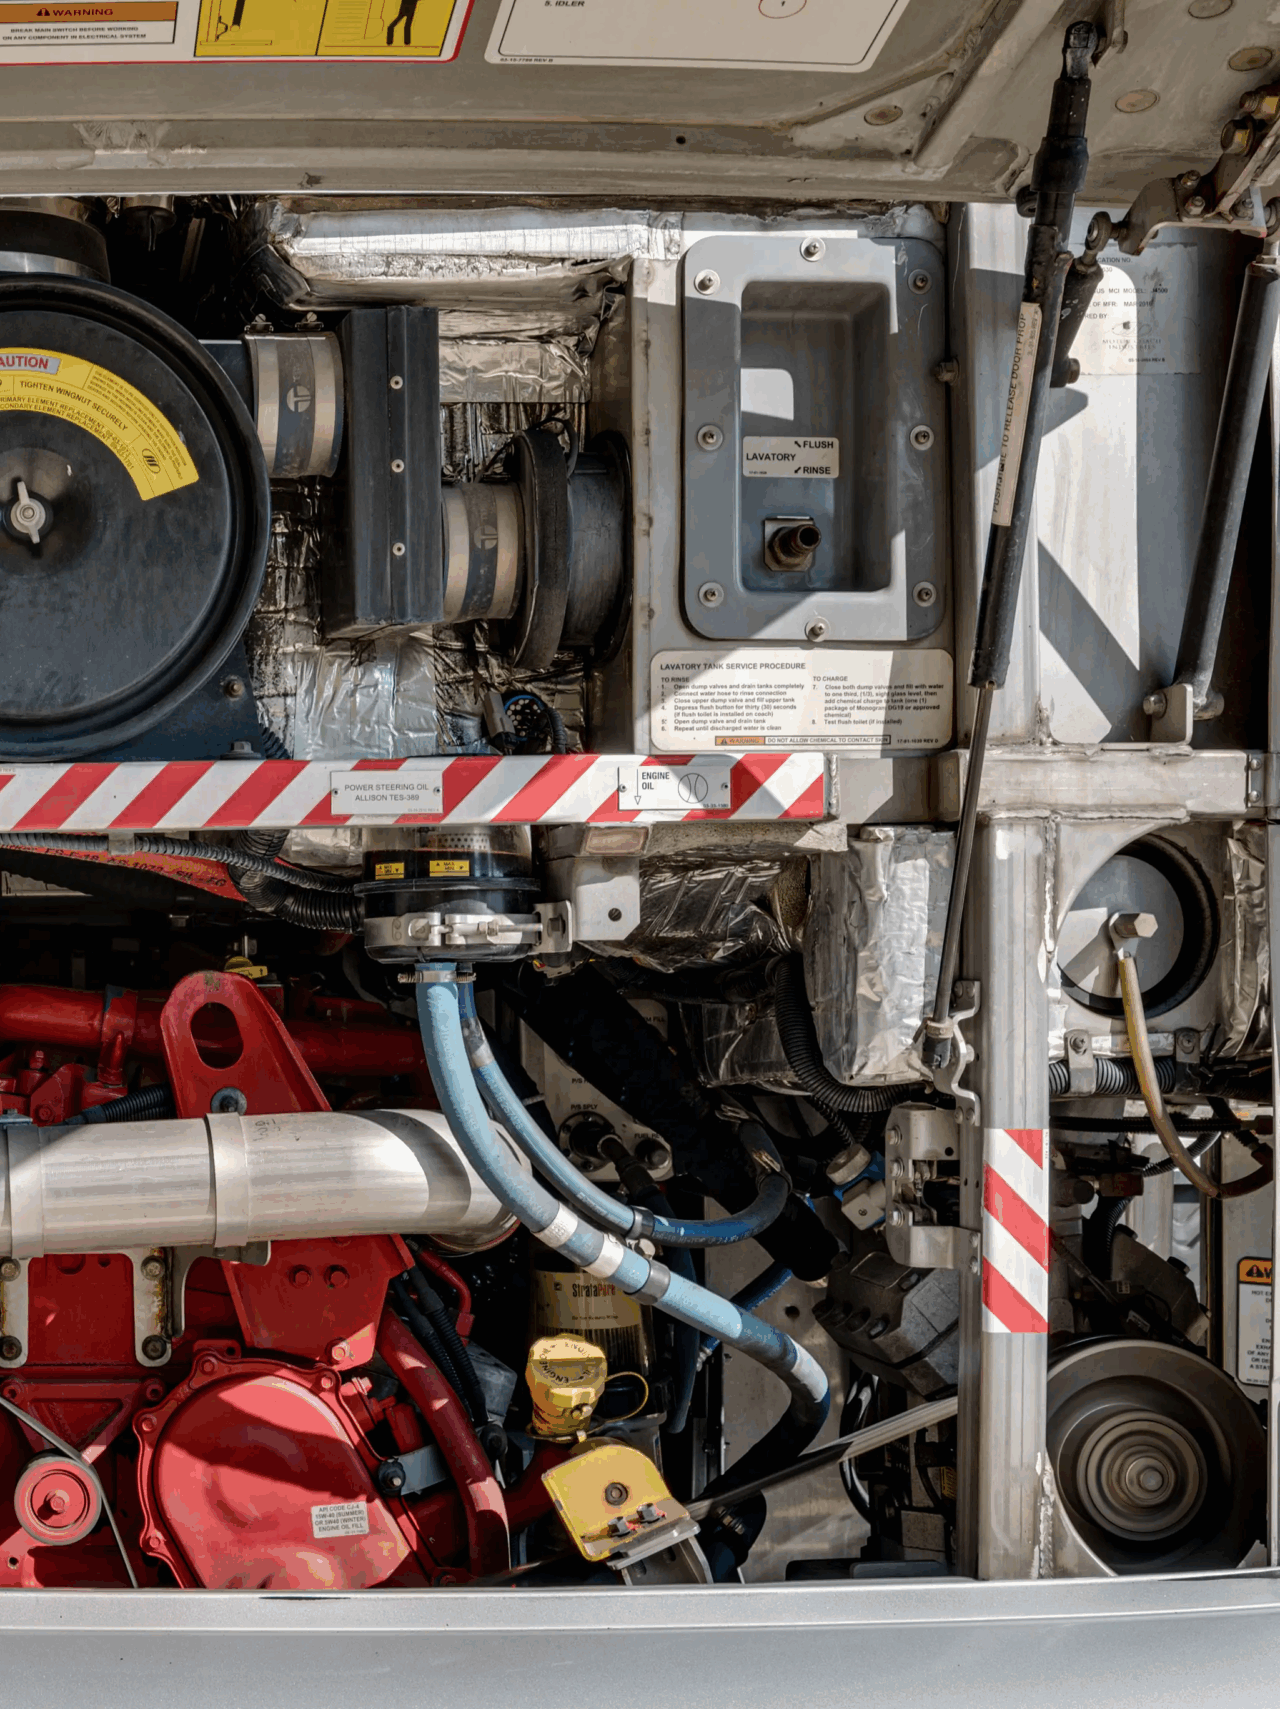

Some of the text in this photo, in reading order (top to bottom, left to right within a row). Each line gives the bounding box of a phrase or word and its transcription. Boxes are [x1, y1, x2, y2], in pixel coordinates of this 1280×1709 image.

[53, 8, 114, 16] WARNING
[1002, 313, 1027, 448] TO RELEASE DOOR PROP
[20, 380, 128, 431] TIGHTEN WINGNUT SECURELY
[27, 397, 58, 409] ELEMENT
[60, 403, 105, 430] REPLACEMENT
[34, 404, 65, 418] ELEMENT
[65, 413, 111, 441] REPLACEMENT
[803, 440, 834, 449] FLUSH
[746, 452, 797, 461] LAVATORY
[803, 466, 831, 475] RINSE
[641, 772, 670, 780] ENGINE
[344, 784, 376, 792] POWER
[376, 783, 415, 791] STEERING
[641, 782, 654, 790] OIL
[336, 1510, 365, 1518] (SUMMER)
[340, 1516, 366, 1524] (WINTER)
